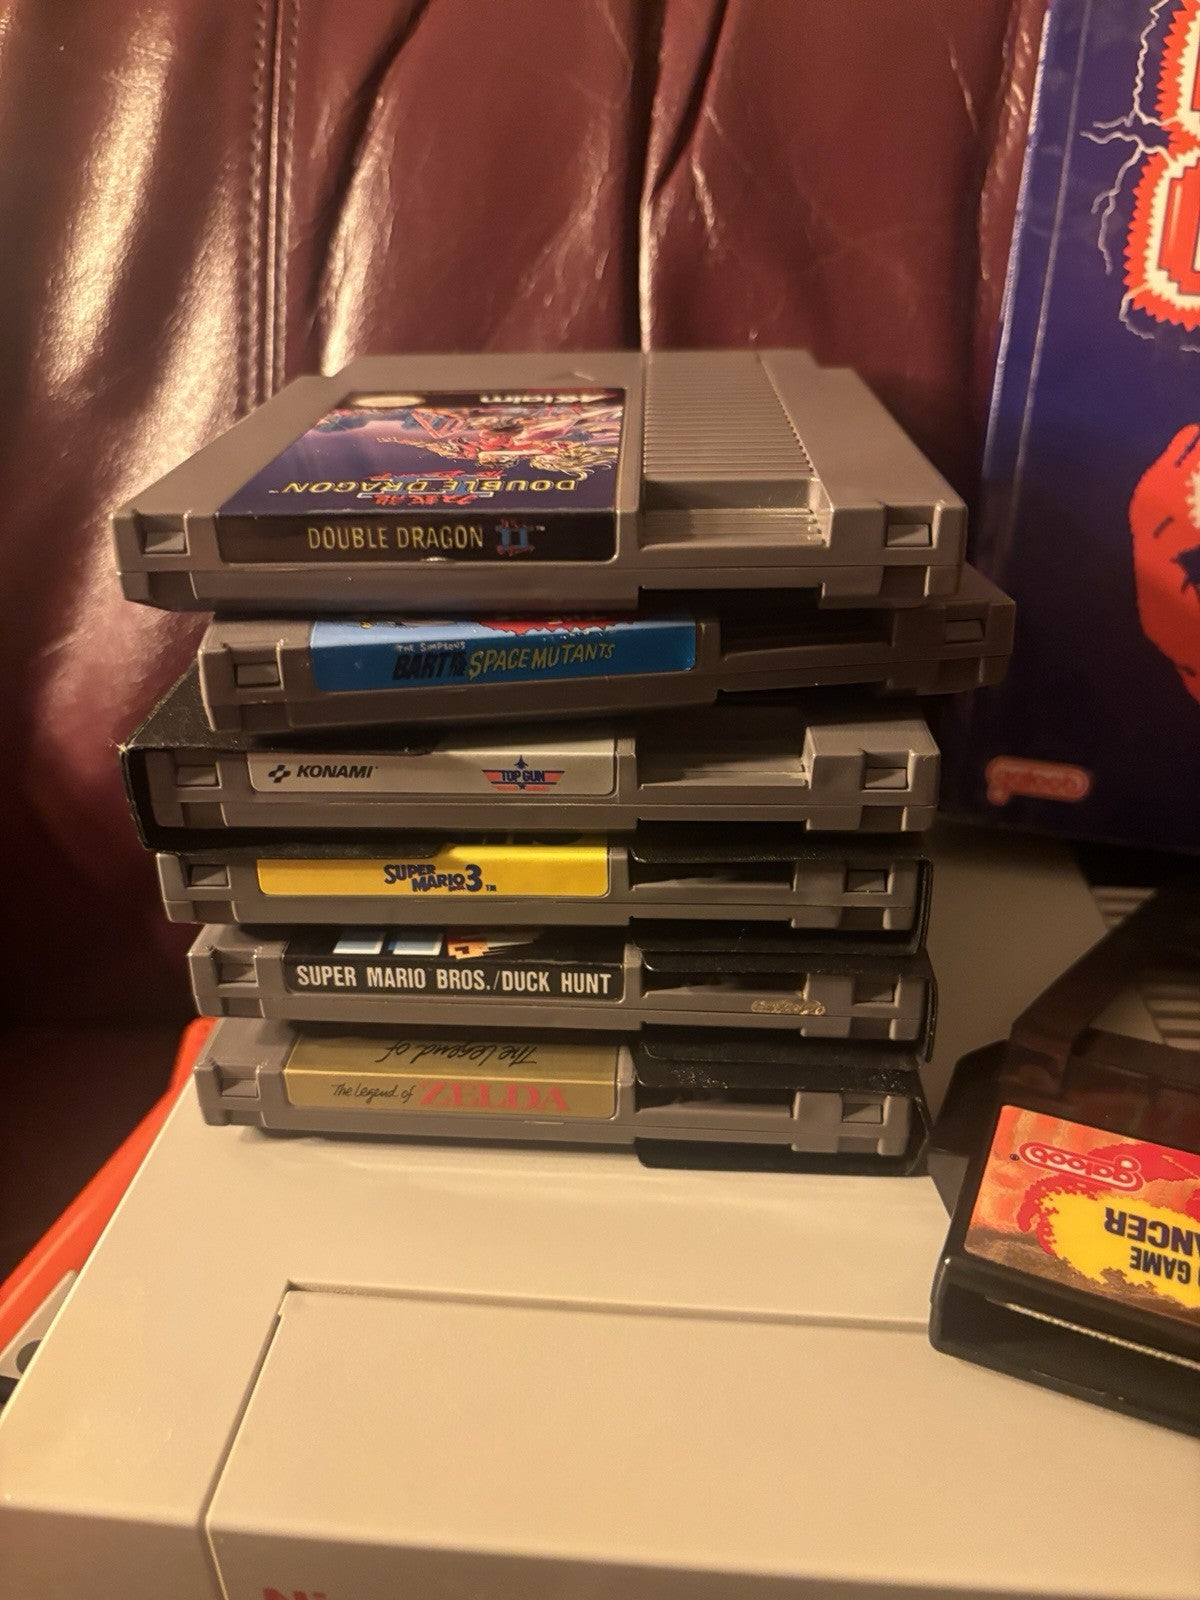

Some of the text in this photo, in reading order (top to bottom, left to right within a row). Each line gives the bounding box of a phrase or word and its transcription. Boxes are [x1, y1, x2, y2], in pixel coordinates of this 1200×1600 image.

[282, 478, 577, 494] DOUBLE DRAGON
[307, 526, 390, 549] DOUBLE
[396, 525, 484, 549] DRAGON
[297, 764, 374, 779] KONAMI
[501, 769, 546, 783] TOP GUN
[383, 863, 436, 885] SUPER
[412, 873, 465, 892] MARIO
[464, 863, 483, 892] 3
[296, 965, 357, 988] SUPER
[366, 966, 426, 989] MARIO
[560, 971, 612, 995] HUNT
[375, 1040, 411, 1064] of
[497, 1044, 538, 1068] The
[331, 1082, 354, 1097] The
[400, 1084, 417, 1104] of
[417, 1078, 571, 1113] ZELDA
[1028, 1145, 1141, 1185] galoob
[1129, 1245, 1191, 1285] GAME
